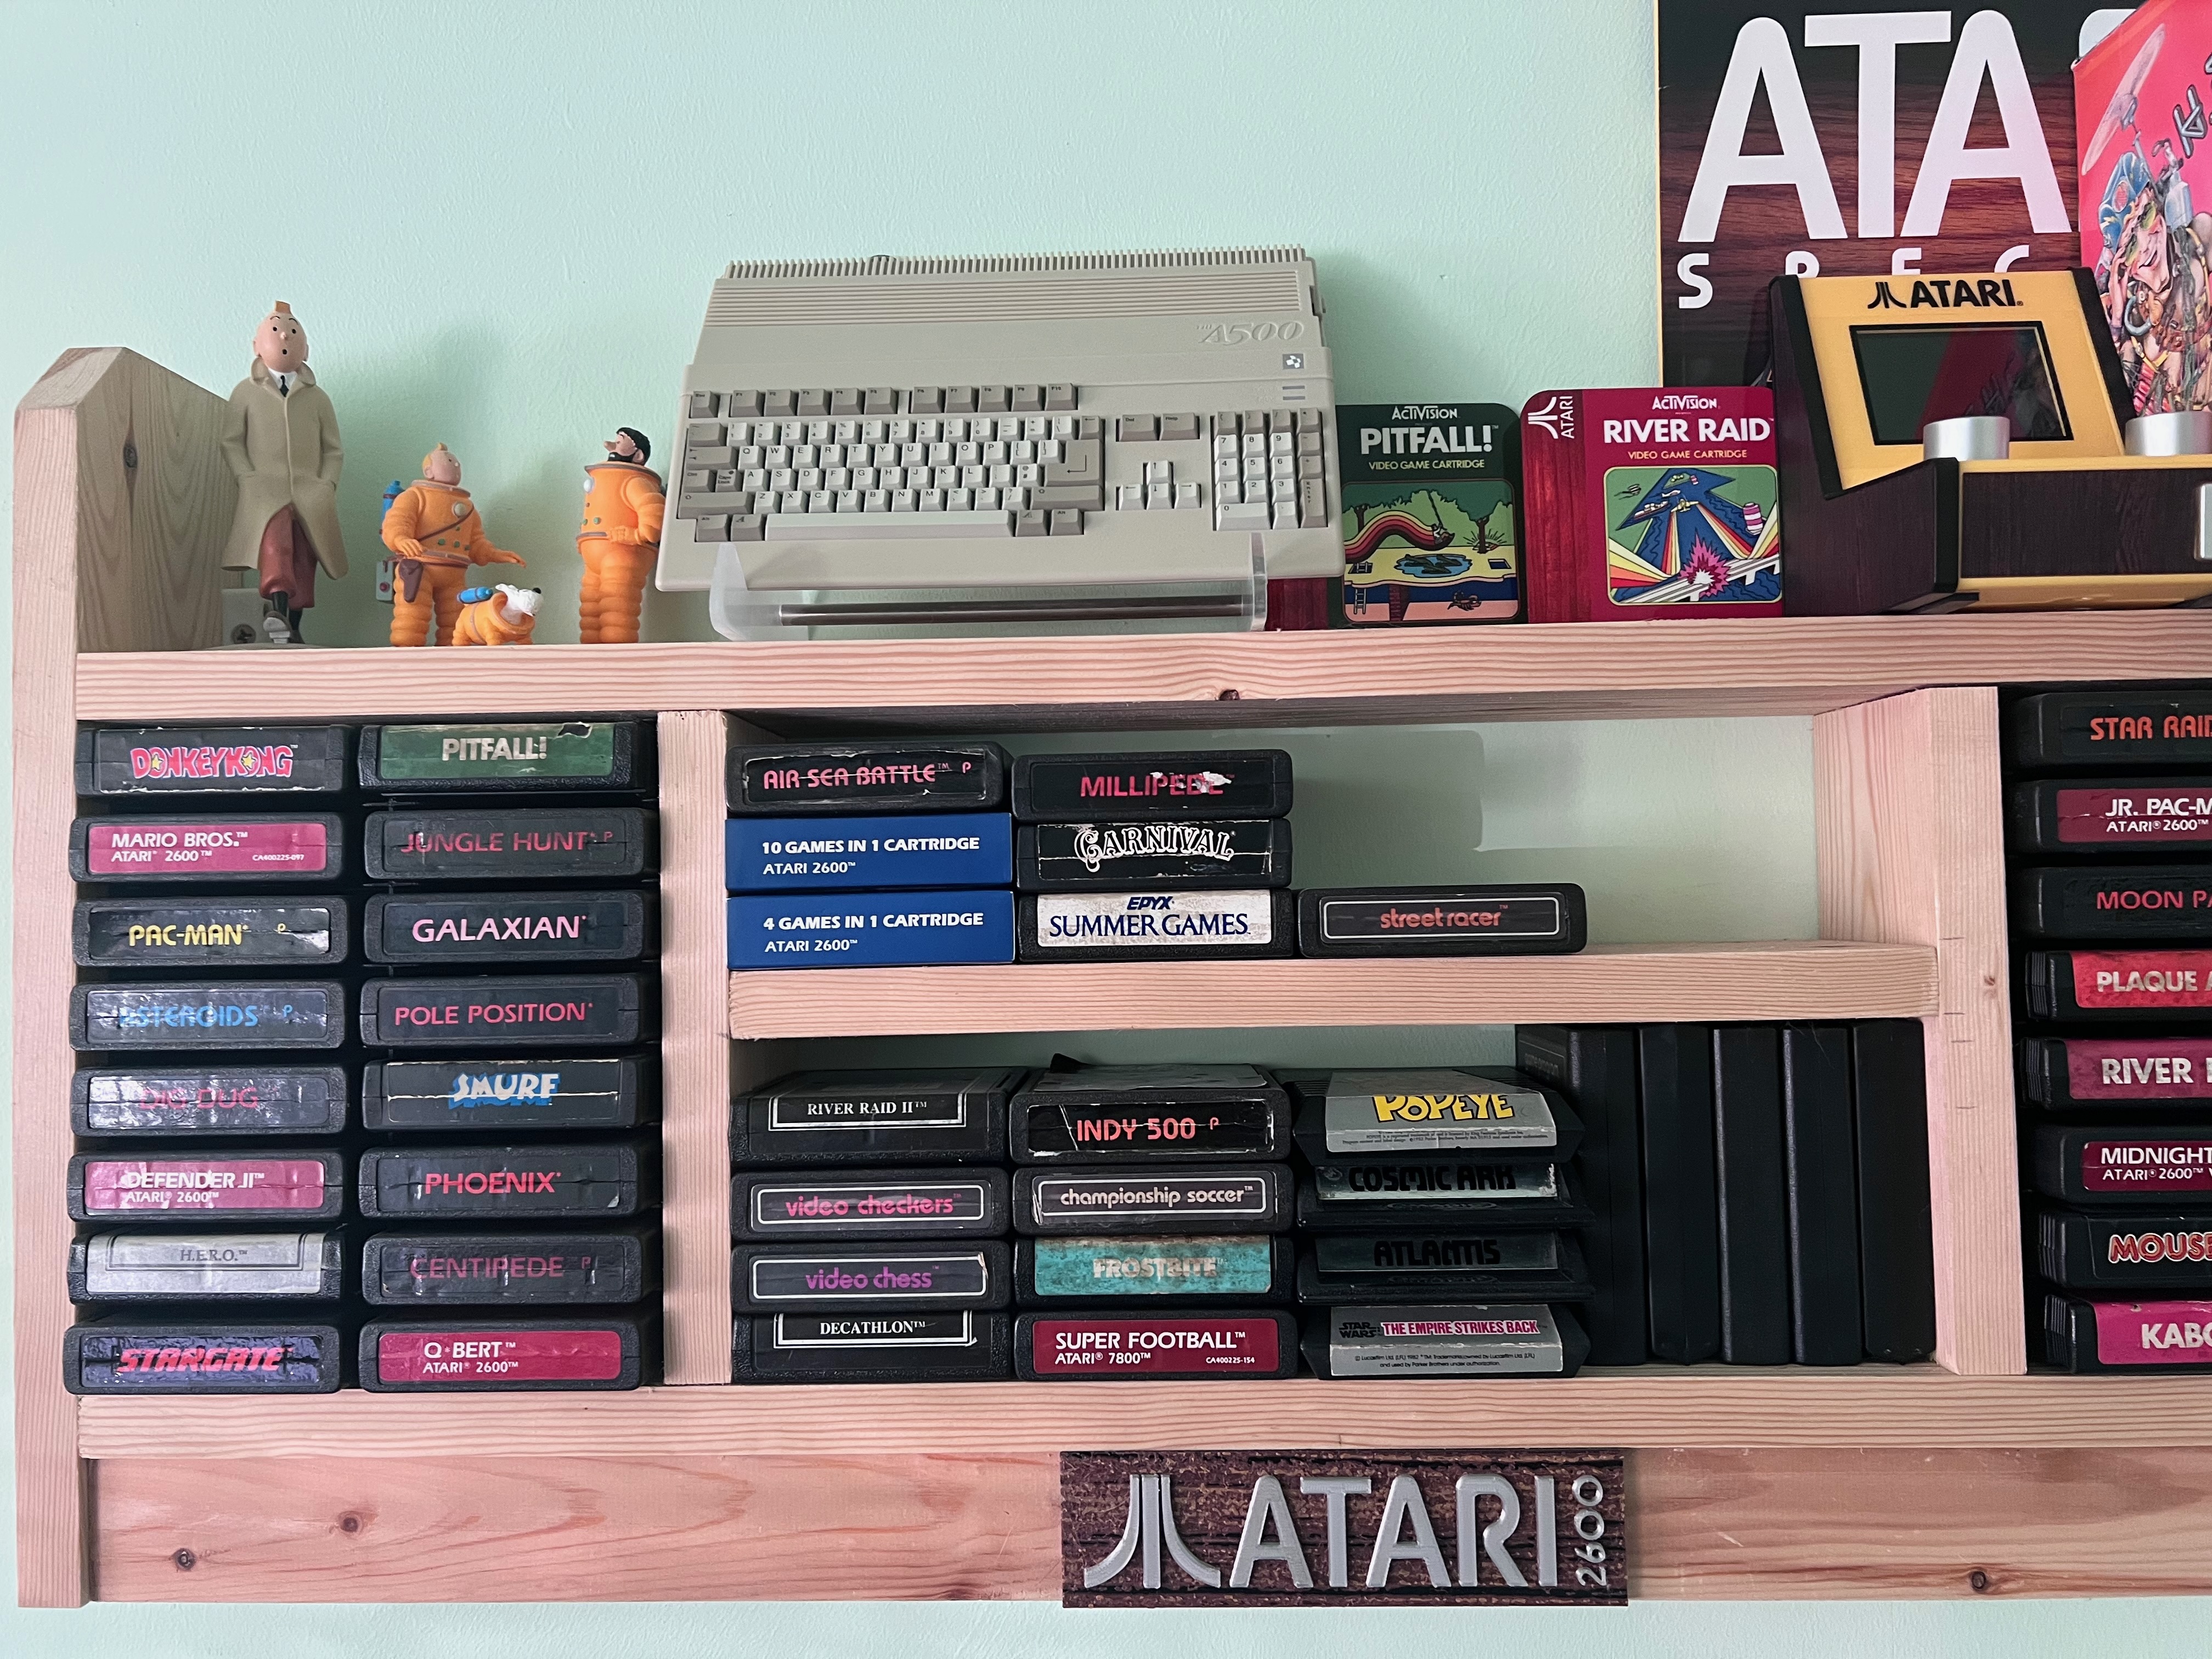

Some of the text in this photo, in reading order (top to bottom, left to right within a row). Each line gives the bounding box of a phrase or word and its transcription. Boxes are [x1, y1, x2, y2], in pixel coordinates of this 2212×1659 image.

[1678, 9, 2136, 242] ATA
[1560, 396, 1575, 439] ATARI
[1604, 419, 1690, 443] RIVER
[1369, 459, 1485, 470] VIDEO GAME CARTRIDGE
[1628, 450, 1747, 460] VIDEO GAME CARTRIDGE
[2090, 718, 2153, 741] STAR
[442, 737, 548, 761] PITFALL!
[130, 747, 225, 779] DONKEY
[764, 770, 799, 789] AIR
[807, 769, 850, 788] SEA
[962, 762, 972, 774] P
[2105, 799, 2138, 817] JR.
[111, 833, 177, 848] MARIO
[400, 832, 503, 853] JUNGLE
[763, 837, 979, 854] 10 GAMES IN 1 CARTRIDGE
[763, 863, 807, 874] ATARI
[2096, 891, 2212, 910] MOON P
[763, 913, 983, 930] 4 GAMES IN 1 CARTRIDGE
[1049, 913, 1249, 937] SUMMER GAMES
[1380, 907, 1444, 928] street
[278, 923, 286, 934] P
[765, 940, 809, 952] ATARI
[2097, 971, 2198, 992] PLAQUE
[283, 1005, 292, 1018] P
[395, 1006, 459, 1026] POLE
[2101, 1058, 2193, 1085] RIVER
[197, 1088, 258, 1109] DUG
[449, 1073, 561, 1109] SMURF
[808, 1103, 854, 1115] RIVER
[860, 1102, 896, 1114] RAID
[1372, 1093, 1515, 1122] POPEYE
[1077, 1117, 1220, 1142] INDY 500 P
[126, 1172, 234, 1188] DEFENDER
[1348, 1165, 1516, 1192] COSMIC ARK
[785, 1195, 848, 1217] video
[1060, 1187, 1181, 1207] championship
[1374, 1239, 1500, 1266] ATLANTIS
[411, 1256, 591, 1278] CENTIPEDE P
[805, 1268, 868, 1289] video
[1383, 1321, 1538, 1334] THE EMPIRE STRIKES BACK
[1056, 1333, 1120, 1350] SUPER
[1229, 1474, 1557, 1588] ATARI
[1571, 1475, 1607, 1587] 2600
